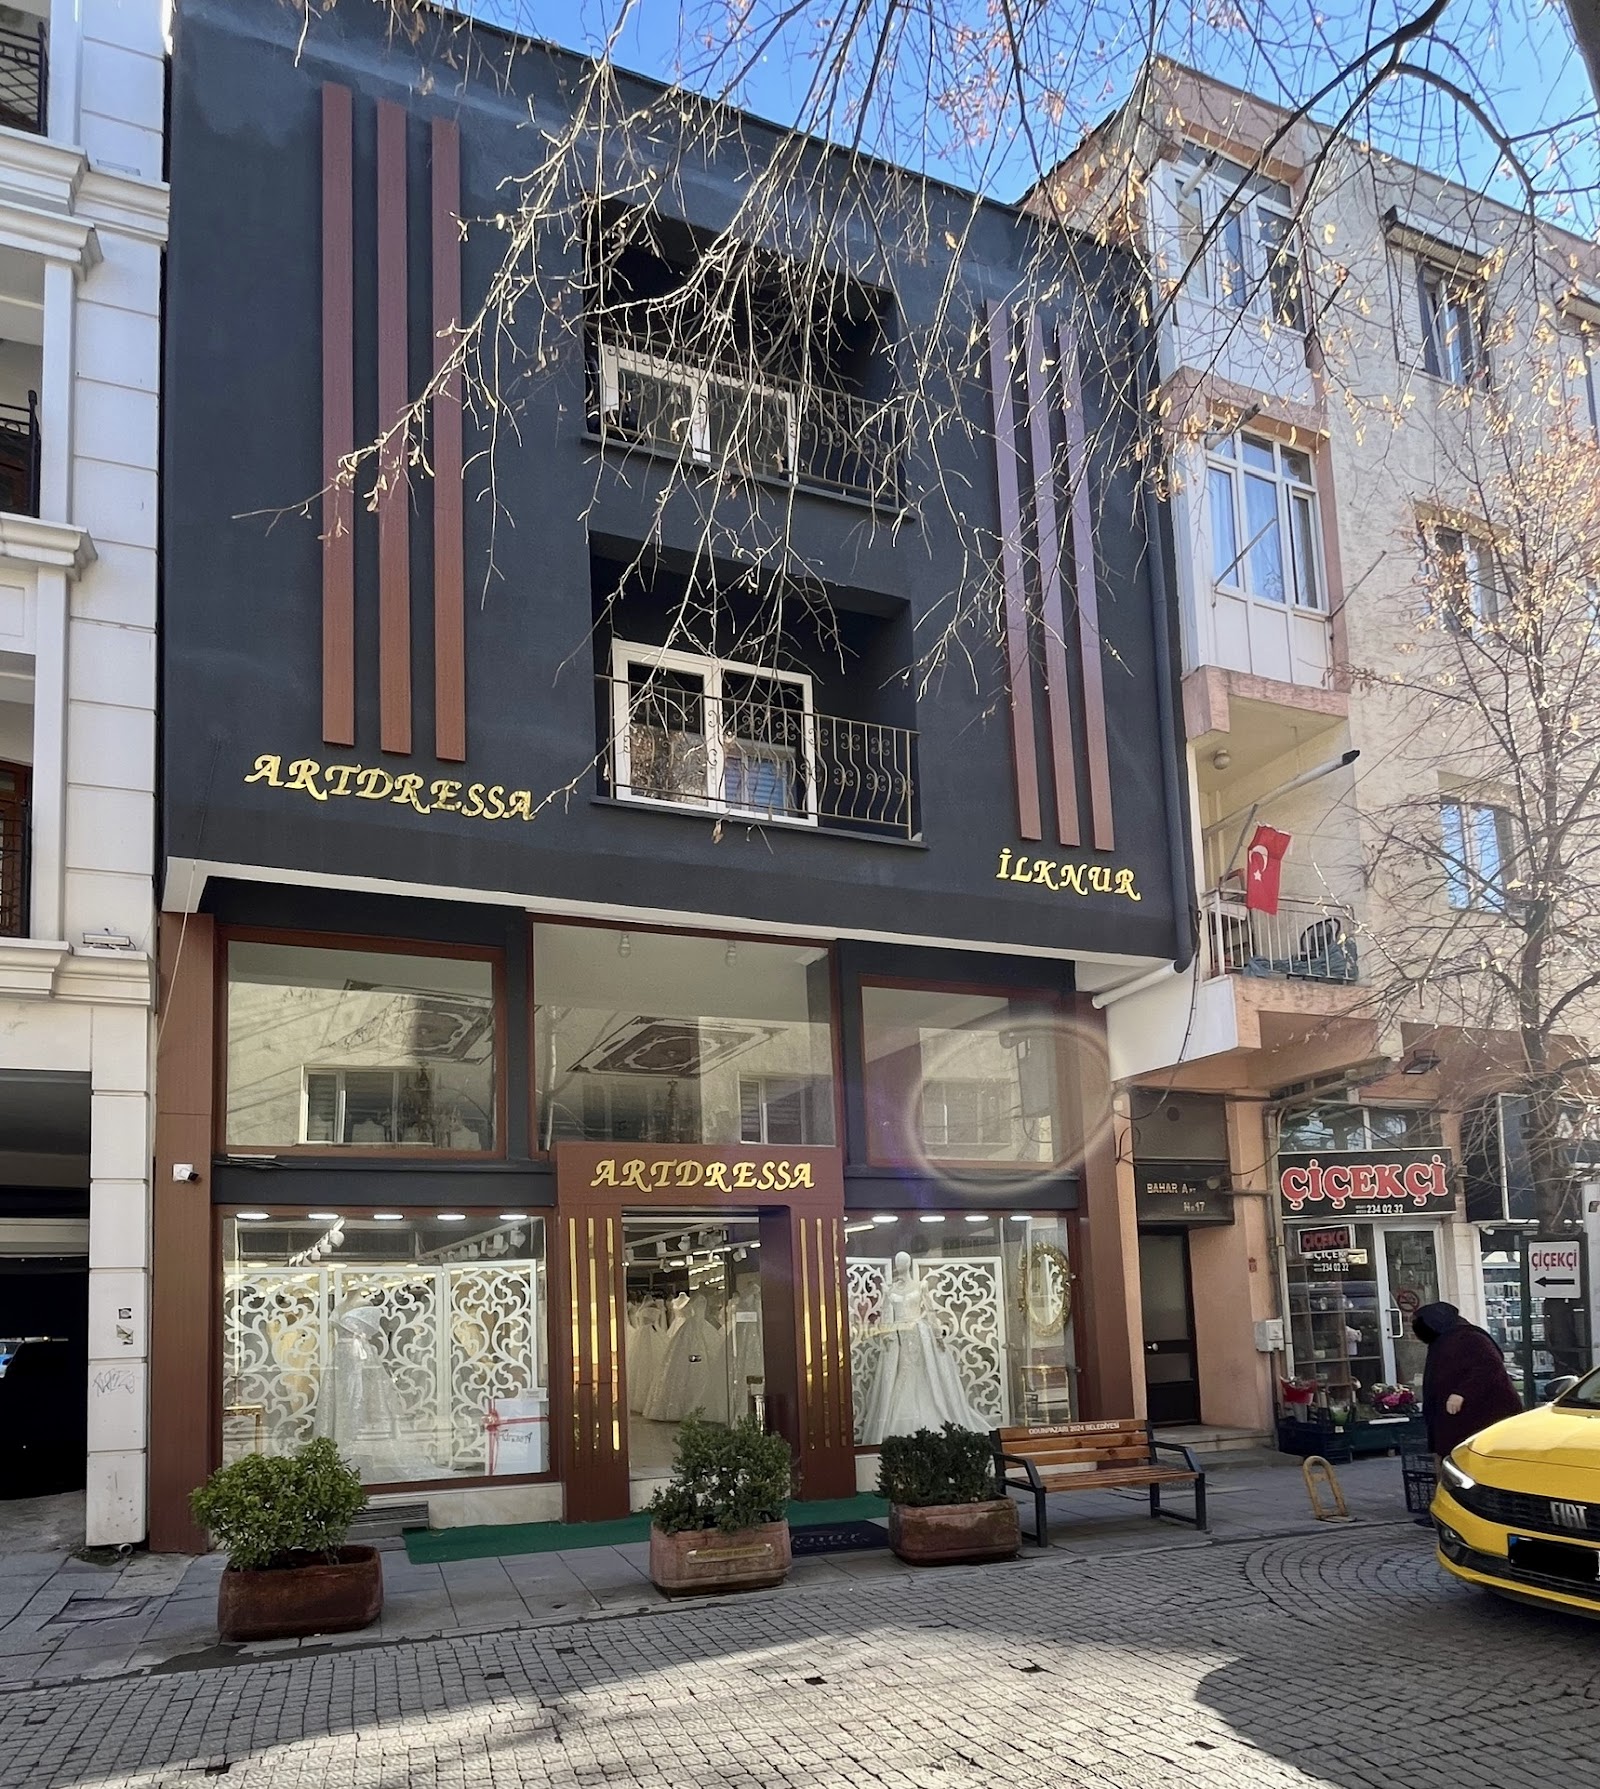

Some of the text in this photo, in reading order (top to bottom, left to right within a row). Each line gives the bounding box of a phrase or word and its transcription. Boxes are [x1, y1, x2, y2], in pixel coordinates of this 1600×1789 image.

[244, 754, 536, 822] ARTDRESSA
[996, 847, 1142, 901] İLKNUR
[590, 1159, 815, 1193] ARTDRESSA
[1146, 1183, 1178, 1194] BAHAR
[1281, 1154, 1449, 1210] ÇİÇEKÇİ
[1366, 1204, 1381, 1214] 234
[1382, 1204, 1392, 1214] 02
[1393, 1203, 1404, 1214] 32
[1321, 1263, 1333, 1272] 234
[1341, 1263, 1349, 1272] 32
[1531, 1249, 1577, 1271] ÇİÇEKÇİ
[1549, 1501, 1588, 1529] FIAT
